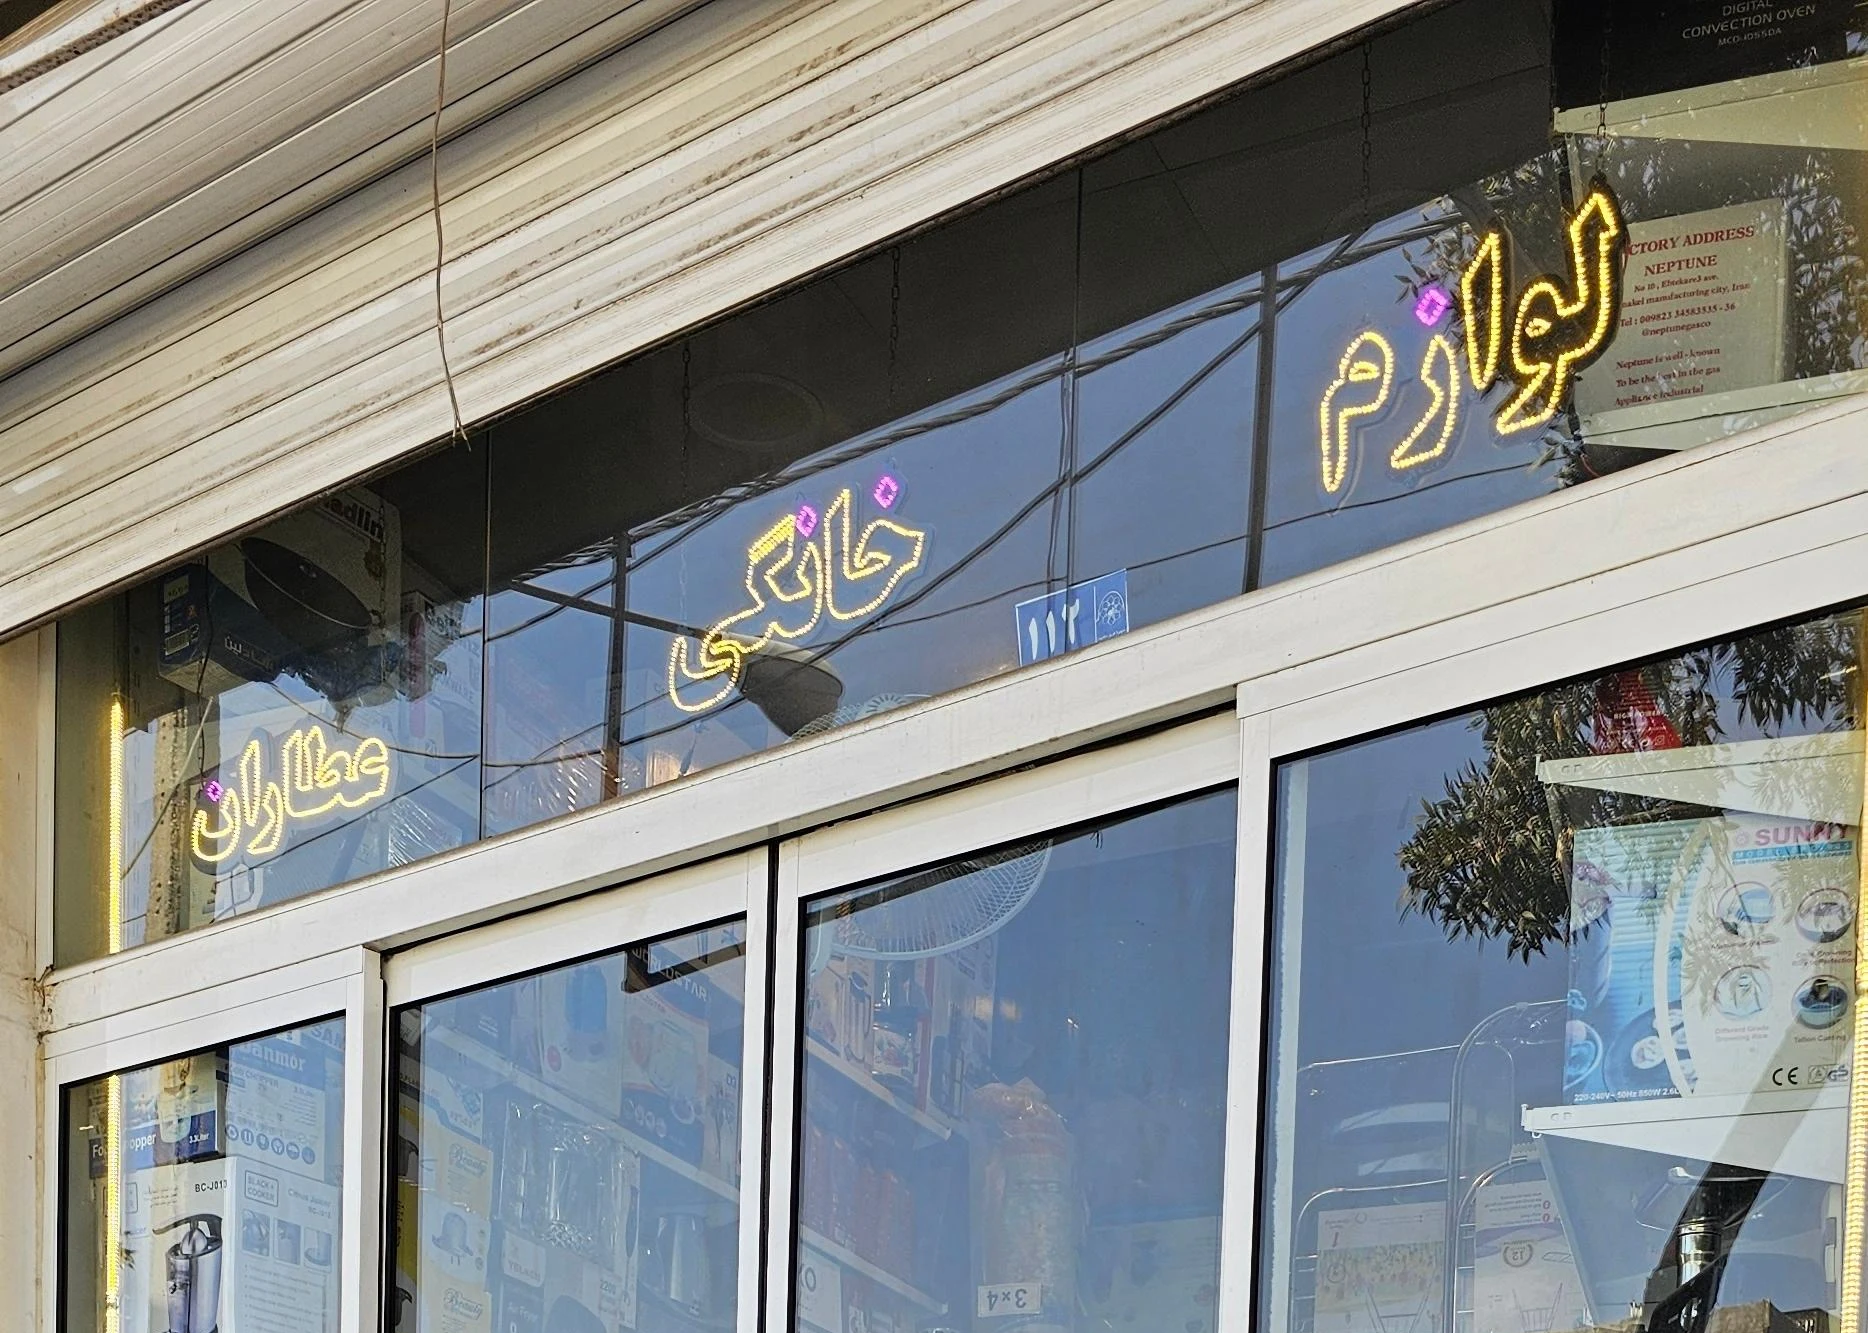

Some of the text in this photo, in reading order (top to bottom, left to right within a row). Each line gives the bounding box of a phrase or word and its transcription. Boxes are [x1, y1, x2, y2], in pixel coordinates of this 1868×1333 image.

[1682, 5, 1816, 39] CONVECTION OVEN
[1683, 225, 1755, 248] ADDRESS
[1643, 254, 1718, 277] NEPTUNE
[1646, 287, 1710, 305] manufacturing
[1616, 357, 1656, 370] Neptune
[1628, 376, 1640, 386] be
[191, 191, 1621, 862] لوازم خانگی عطاران
[1772, 1066, 1799, 1087] CE
